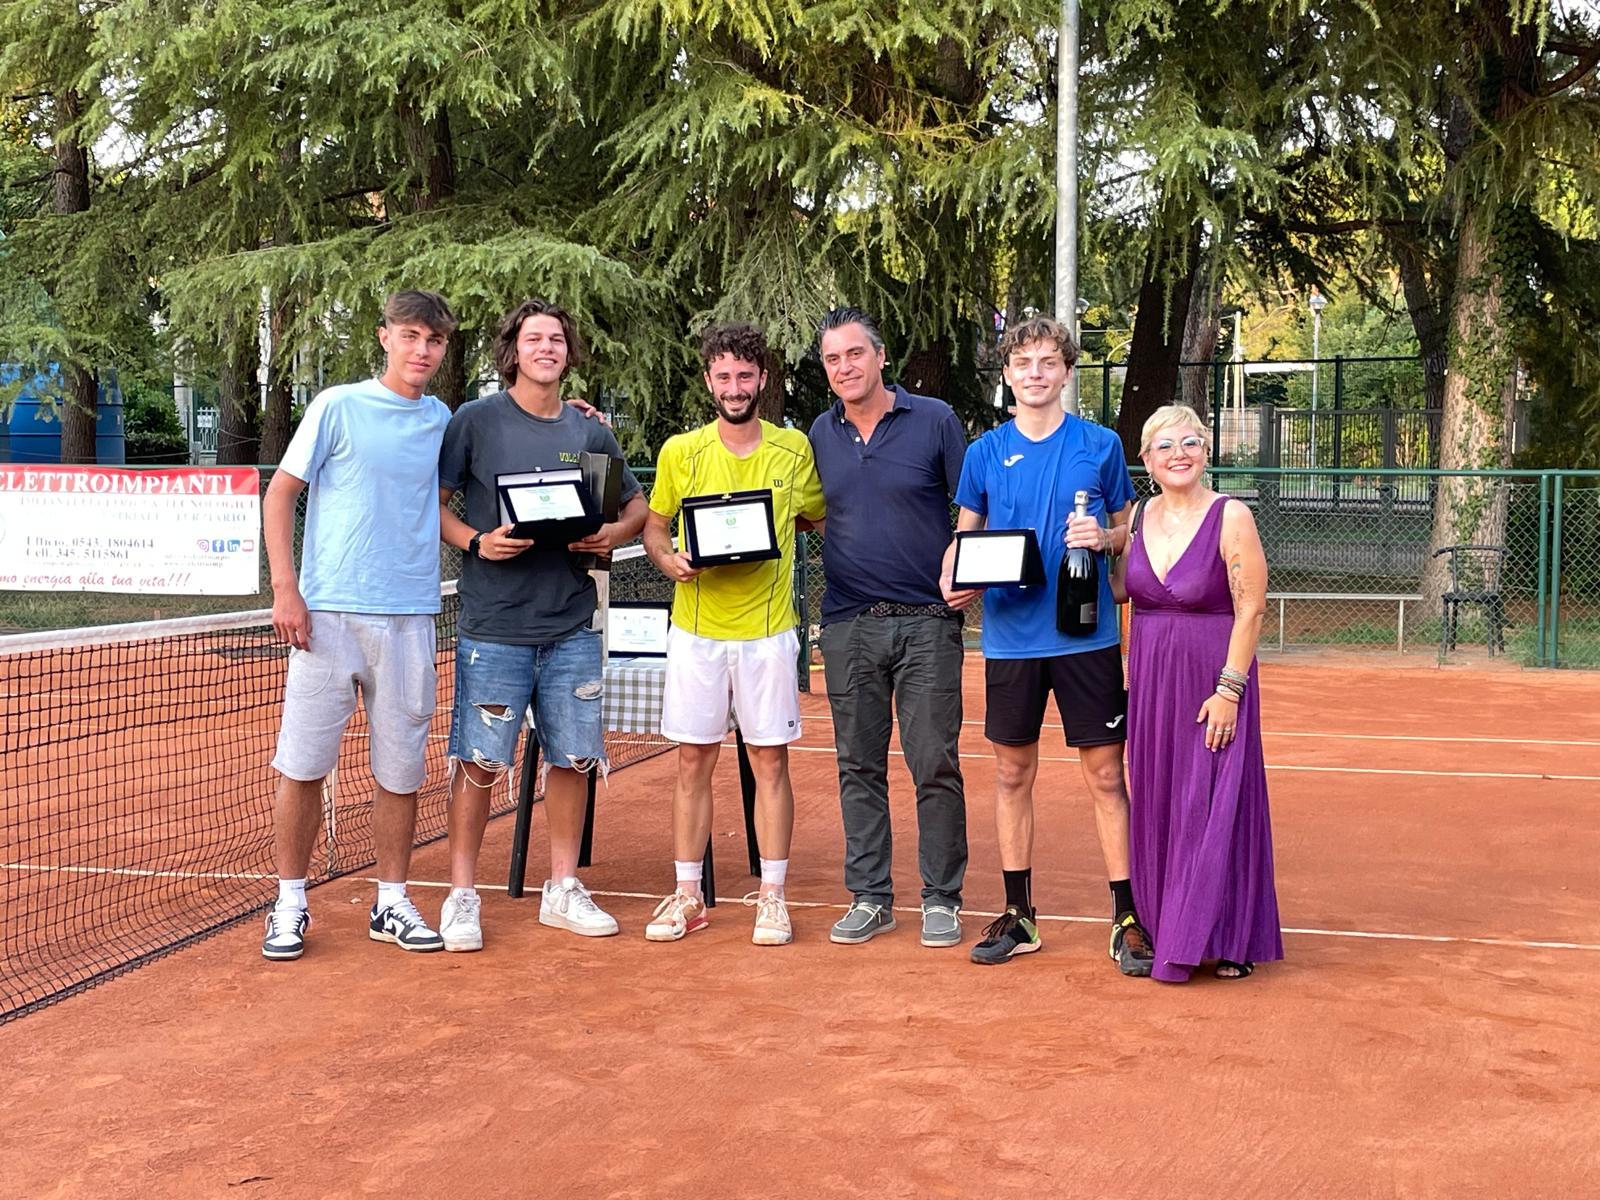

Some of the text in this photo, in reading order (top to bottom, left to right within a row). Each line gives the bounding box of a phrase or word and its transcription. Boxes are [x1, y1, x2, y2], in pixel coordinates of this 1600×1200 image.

[108, 538, 154, 549] 1804614
[83, 549, 129, 560] 5115861
[23, 574, 73, 589] energia
[79, 571, 105, 585] alla
[112, 573, 133, 586] tua
[139, 572, 191, 587] vita!!!
